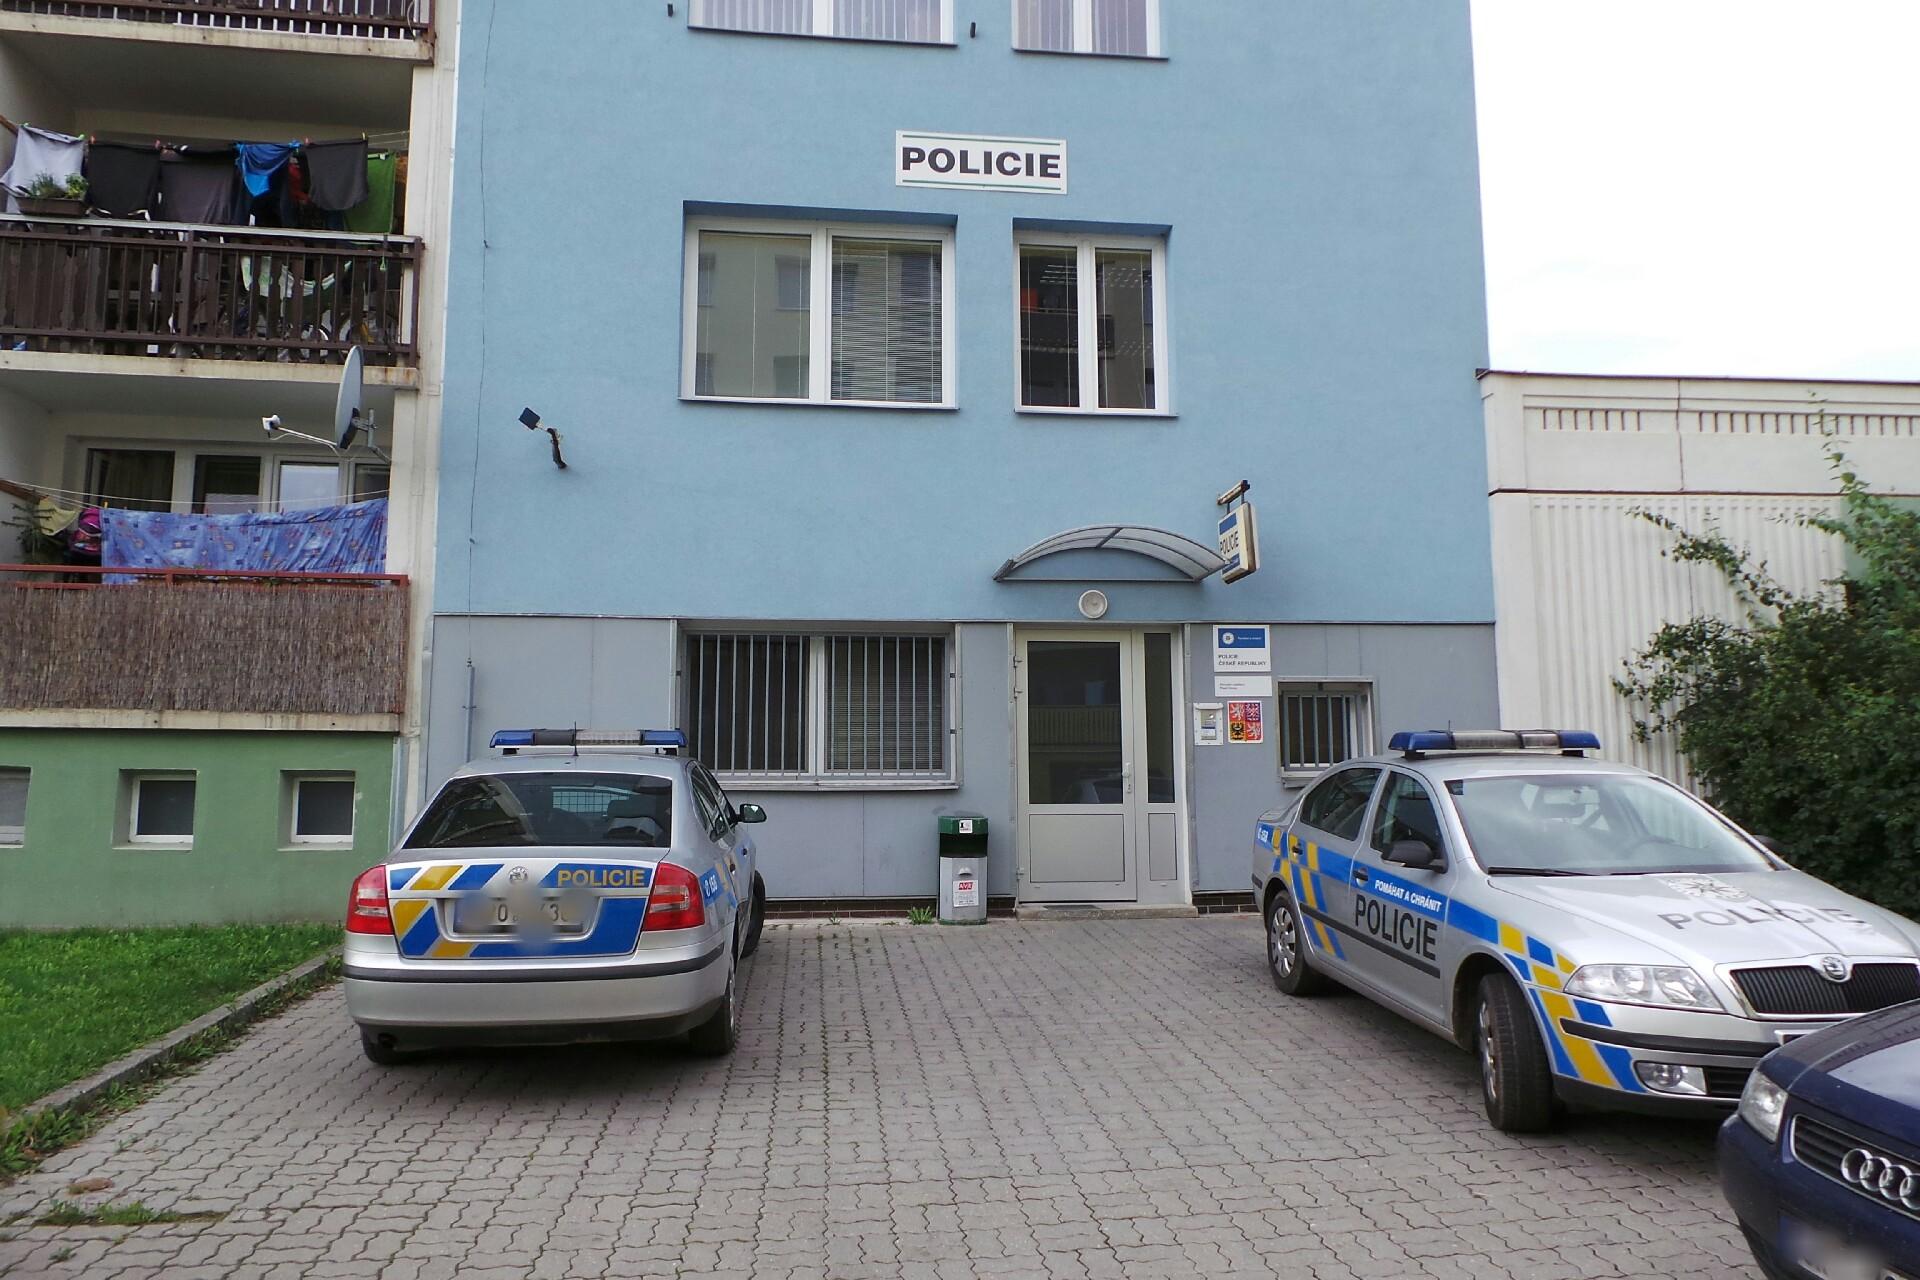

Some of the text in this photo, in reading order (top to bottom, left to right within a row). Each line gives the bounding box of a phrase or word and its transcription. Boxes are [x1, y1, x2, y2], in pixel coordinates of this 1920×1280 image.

[902, 147, 1061, 178] POLICIE
[1220, 531, 1239, 555] POLICIE
[558, 870, 645, 887] POLICIE
[1375, 879, 1442, 912] POMÁHAT A CHRÁNIT
[1355, 894, 1437, 960] POLICIE
[1657, 907, 1867, 930] POLICIE
